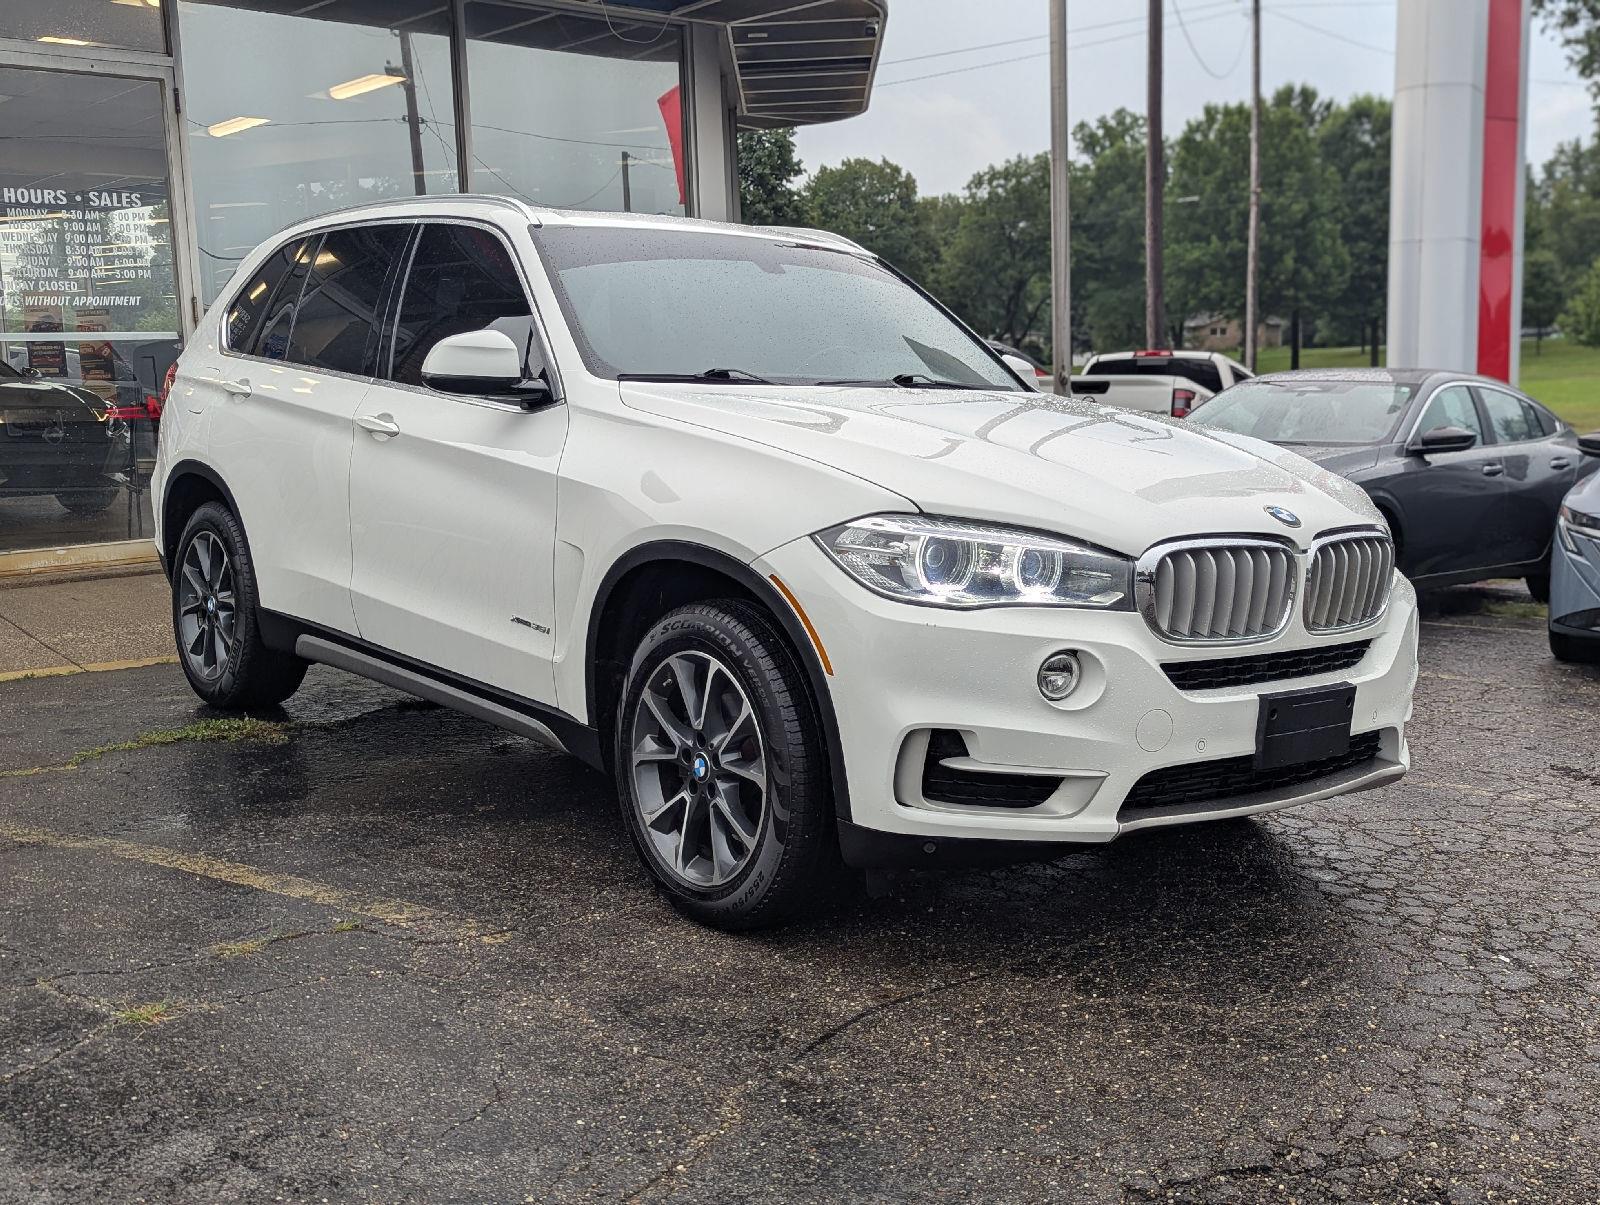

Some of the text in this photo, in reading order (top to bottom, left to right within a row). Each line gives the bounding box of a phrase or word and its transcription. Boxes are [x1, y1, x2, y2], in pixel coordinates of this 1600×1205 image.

[3, 187, 142, 208] HOURS SALES
[6, 208, 48, 218] MONDAY
[84, 210, 99, 220] AM
[132, 212, 146, 222] PM
[64, 222, 84, 231] 9:00
[86, 222, 100, 232] AM
[64, 232, 86, 243] 9:00
[88, 234, 102, 244] AM
[134, 236, 148, 244] PM
[66, 246, 86, 254] 8:30
[88, 246, 102, 256] AM
[67, 257, 88, 266] 9:00
[90, 258, 104, 266] AM
[68, 268, 89, 278] 9:00
[91, 269, 105, 278] AM
[138, 270, 152, 279] PM
[39, 280, 78, 290] CLOSED
[25, 296, 70, 306] WITHOUT
[72, 296, 141, 306] APPOINTMENT
